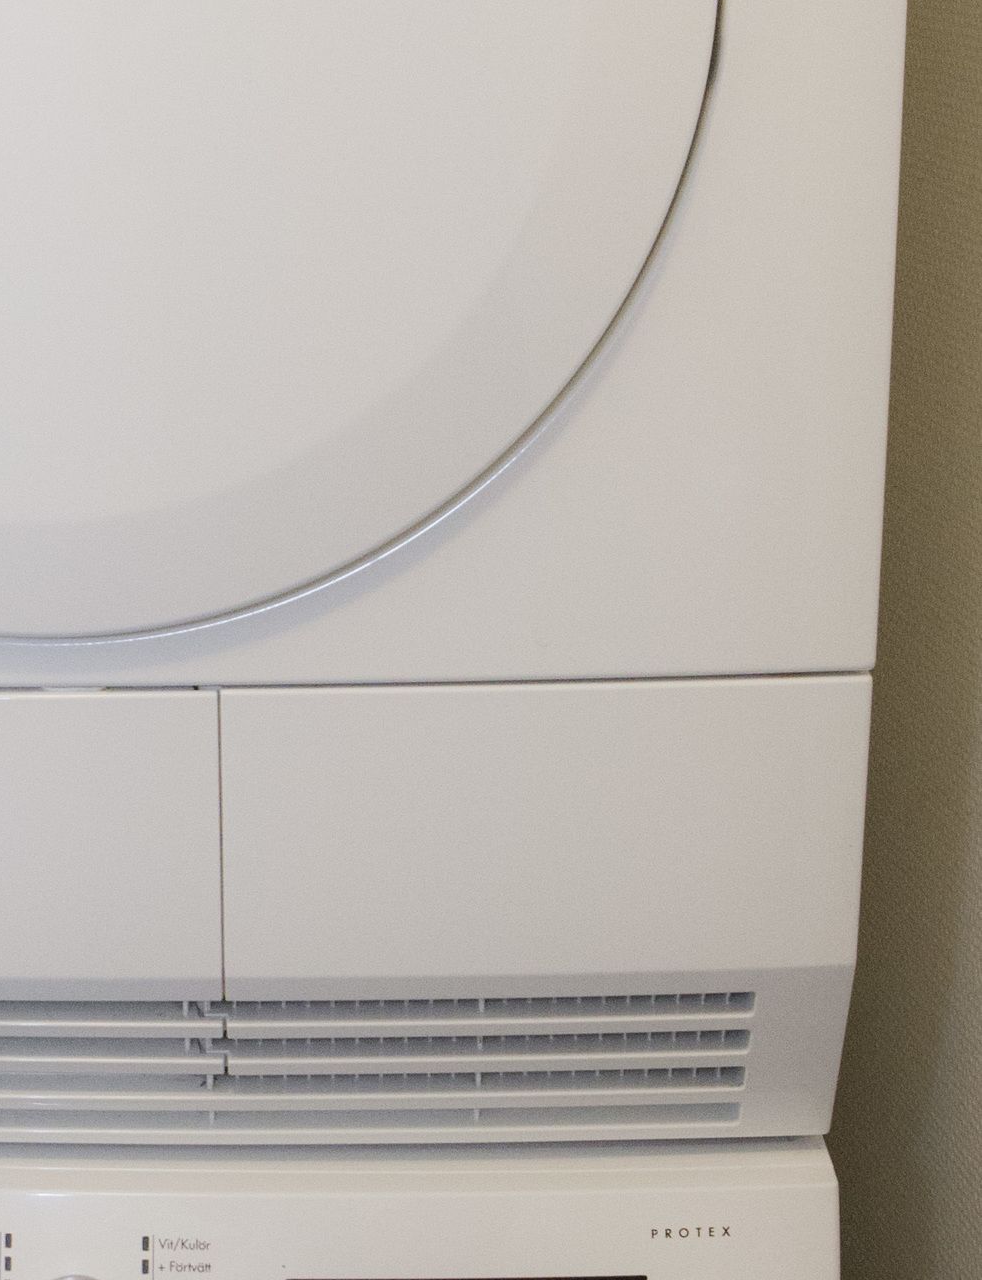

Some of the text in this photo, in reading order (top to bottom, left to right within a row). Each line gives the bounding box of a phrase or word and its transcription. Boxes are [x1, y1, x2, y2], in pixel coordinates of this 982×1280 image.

[651, 1227, 731, 1239] PROTEX
[158, 1238, 210, 1251] Vit/Kulör
[170, 1261, 212, 1273] Förtvätt
